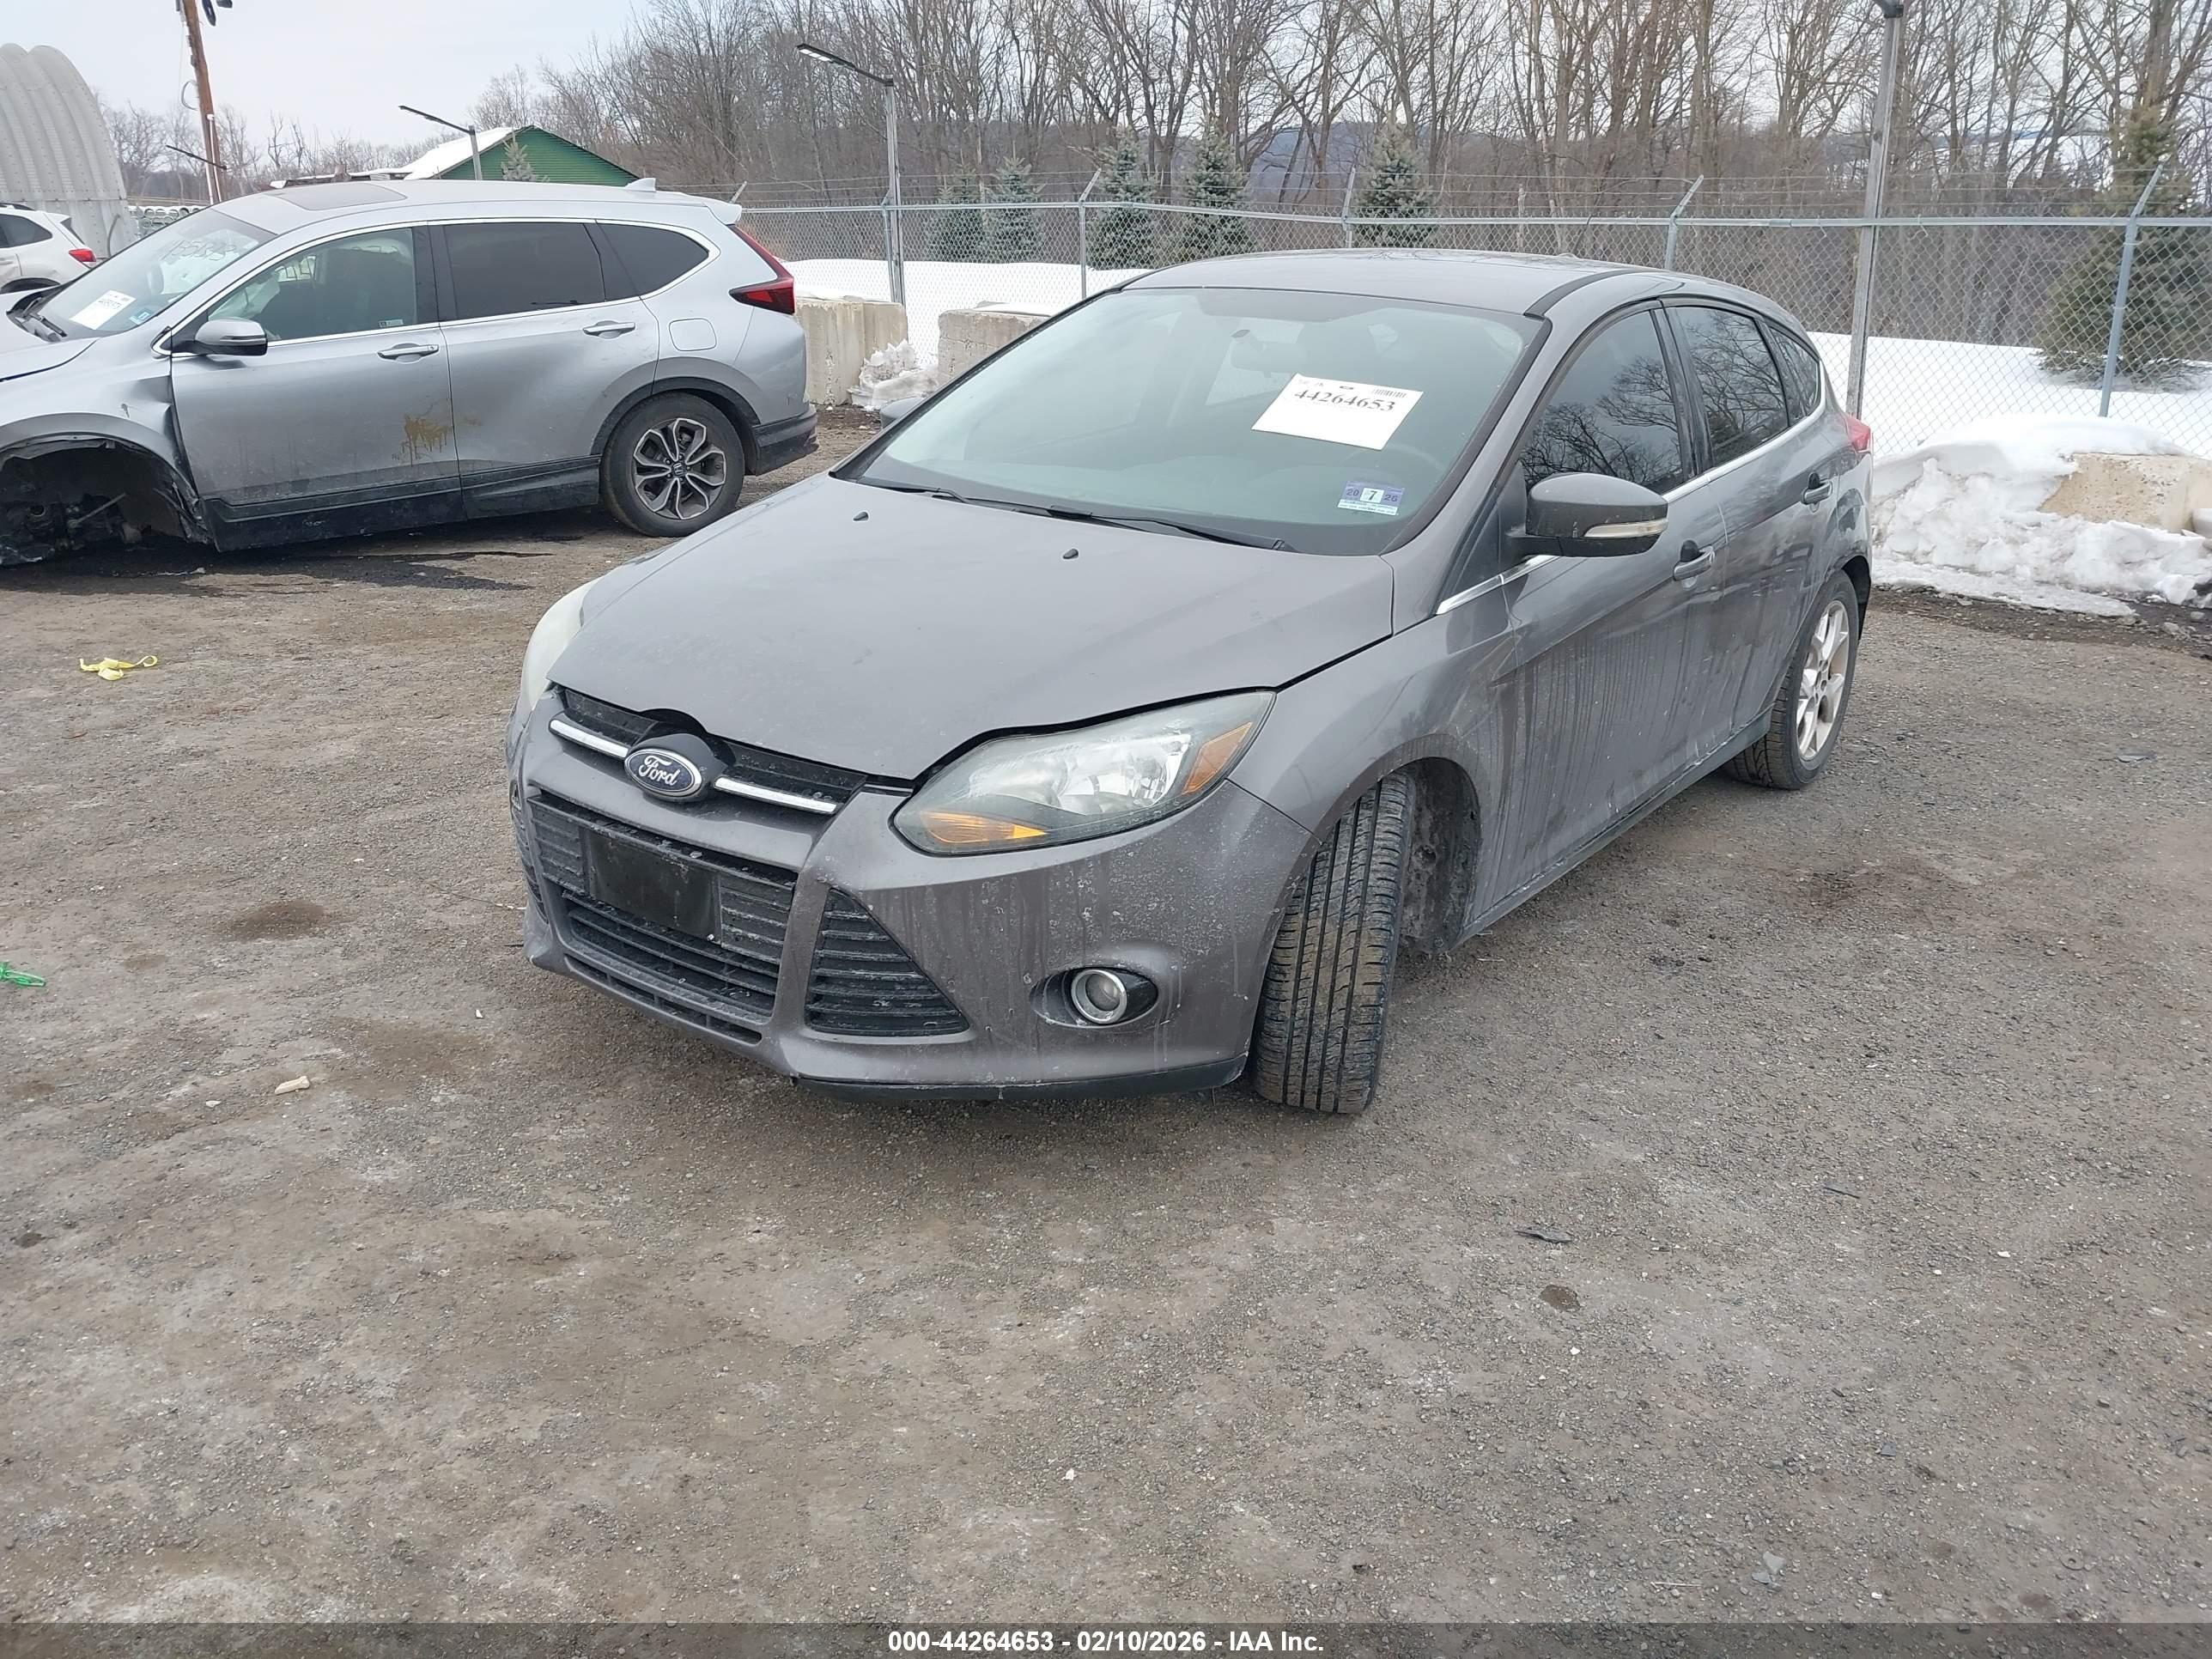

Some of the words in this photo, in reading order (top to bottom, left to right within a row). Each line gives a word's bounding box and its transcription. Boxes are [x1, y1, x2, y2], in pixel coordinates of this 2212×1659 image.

[1293, 389, 1396, 412] 44264653
[1346, 488, 1360, 496] 20
[1368, 490, 1377, 501] 7
[638, 755, 681, 786] Ford
